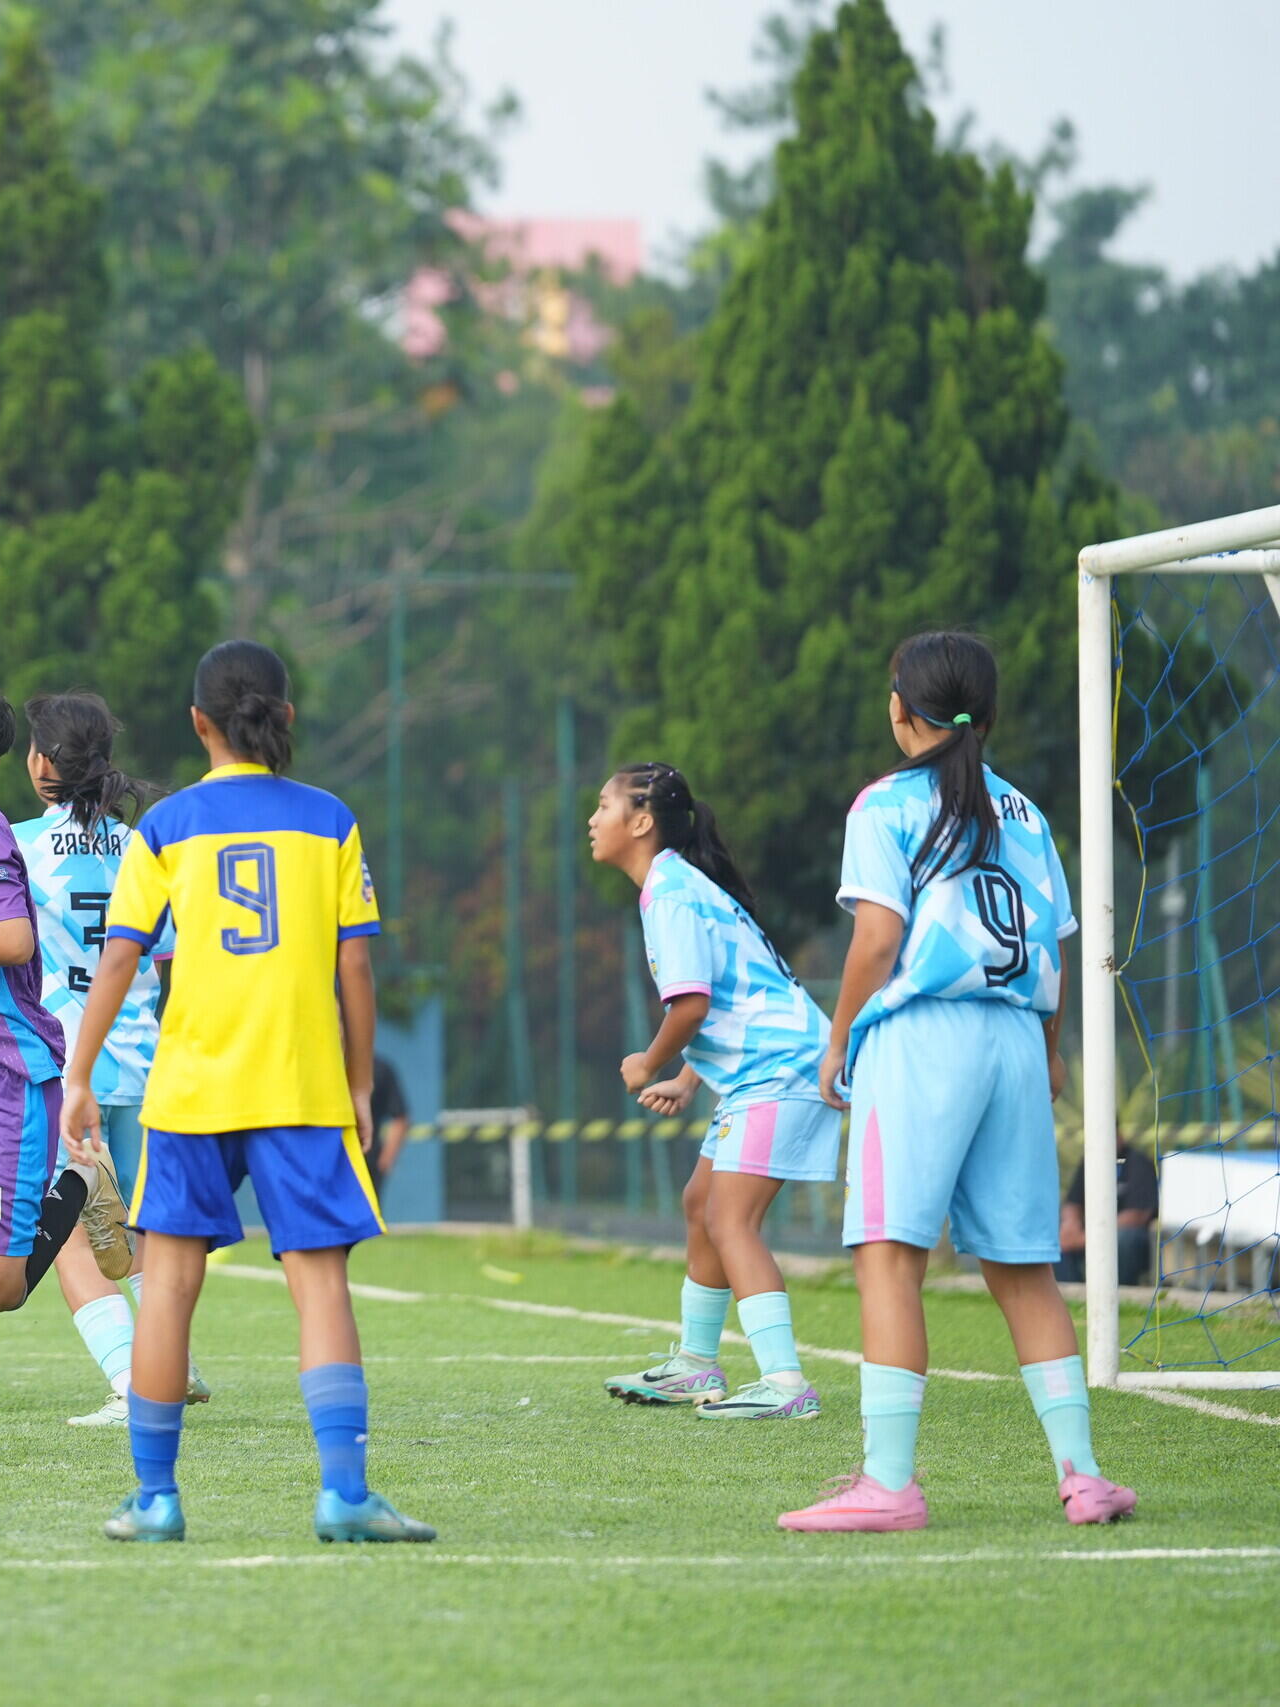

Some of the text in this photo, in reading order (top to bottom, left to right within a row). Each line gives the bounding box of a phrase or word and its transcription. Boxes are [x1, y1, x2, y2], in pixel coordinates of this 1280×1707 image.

[51, 832, 122, 856] ZASKIA
[217, 842, 279, 955] 9
[972, 861, 1029, 988] 9
